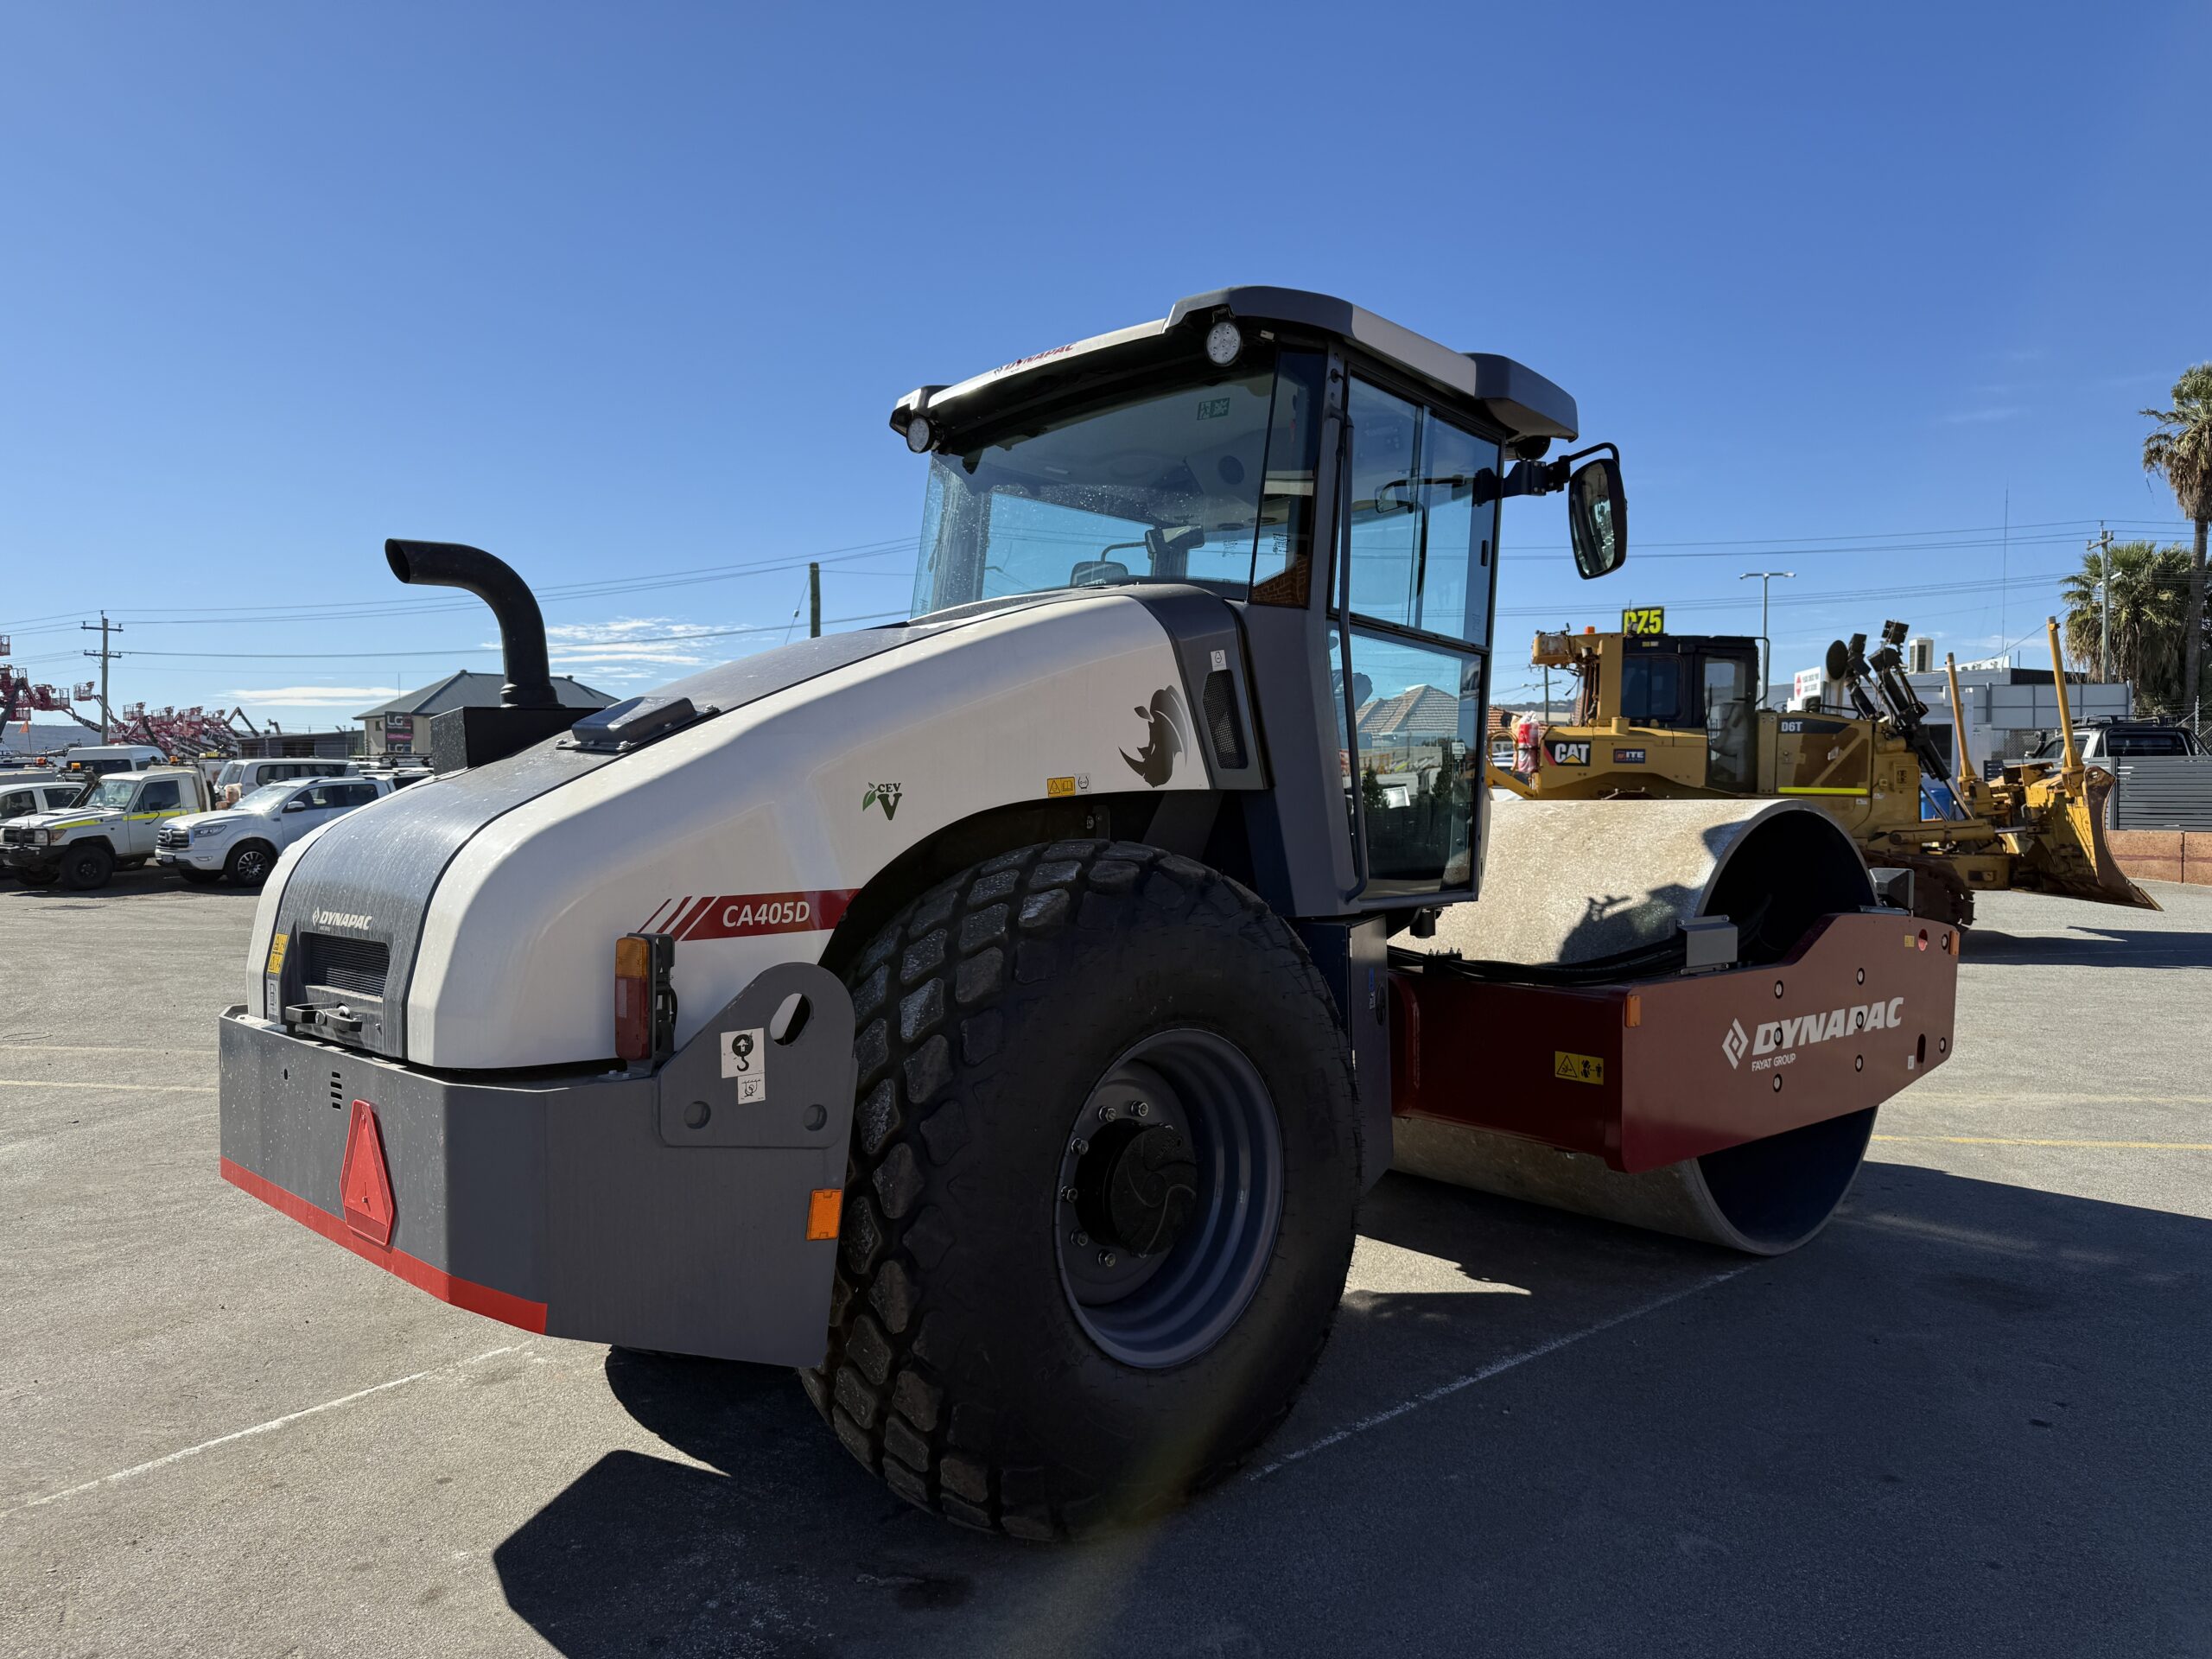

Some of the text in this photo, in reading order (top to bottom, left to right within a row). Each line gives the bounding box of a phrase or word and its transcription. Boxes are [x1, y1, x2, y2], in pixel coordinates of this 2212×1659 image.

[1781, 721, 1802, 732] D6T
[1554, 743, 1589, 763] CAT
[877, 783, 901, 793] CEV
[877, 793, 902, 821] V
[319, 911, 372, 931] DYNAPAC
[722, 901, 810, 927] CA405D
[1751, 996, 1904, 1056] DYNAPAC
[1751, 1052, 1796, 1071] FAYAT GROUP
